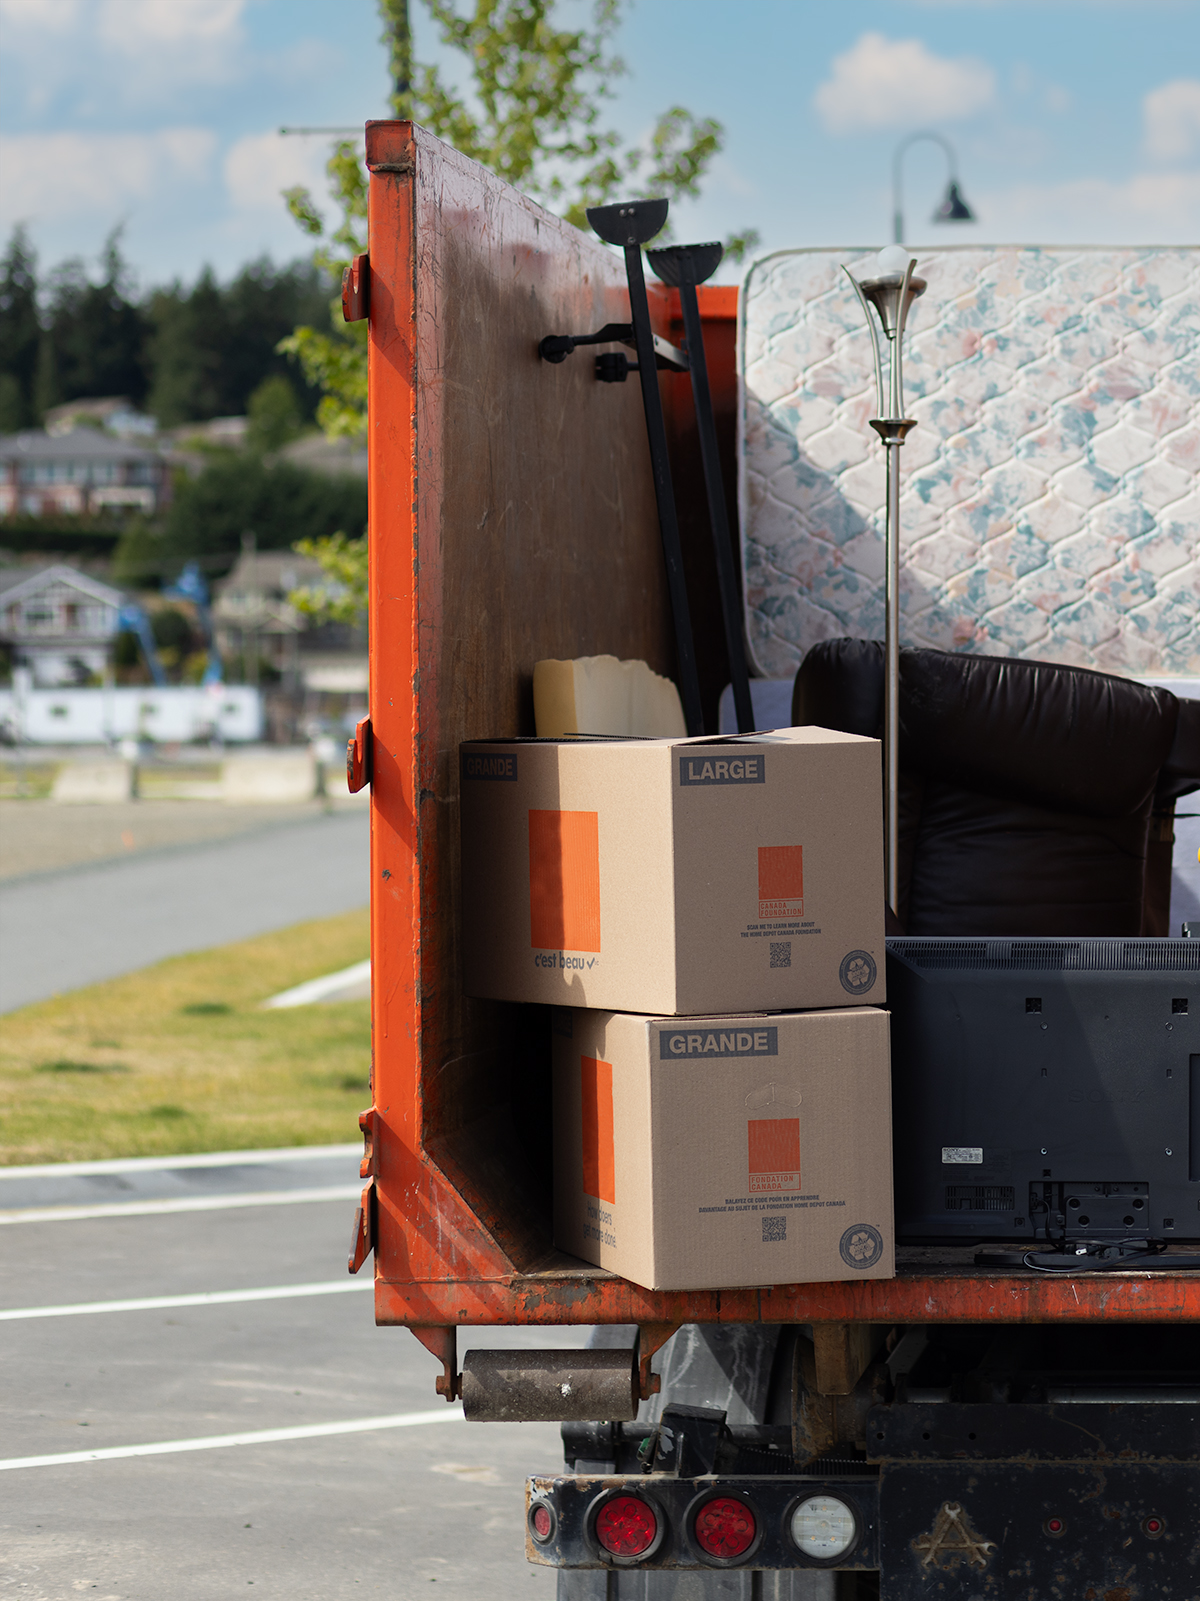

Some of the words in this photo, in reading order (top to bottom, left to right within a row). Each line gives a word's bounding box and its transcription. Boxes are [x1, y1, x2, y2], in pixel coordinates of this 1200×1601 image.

[466, 756, 514, 776] GRANDE
[688, 760, 759, 780] LARGE
[760, 902, 787, 910] CANADA
[760, 908, 802, 917] FOUNDATION
[535, 953, 556, 968] c'est
[559, 951, 585, 970] beau
[669, 1032, 769, 1054] GRANDE
[751, 1175, 794, 1184] FONDATION
[751, 1182, 782, 1191] CANADA
